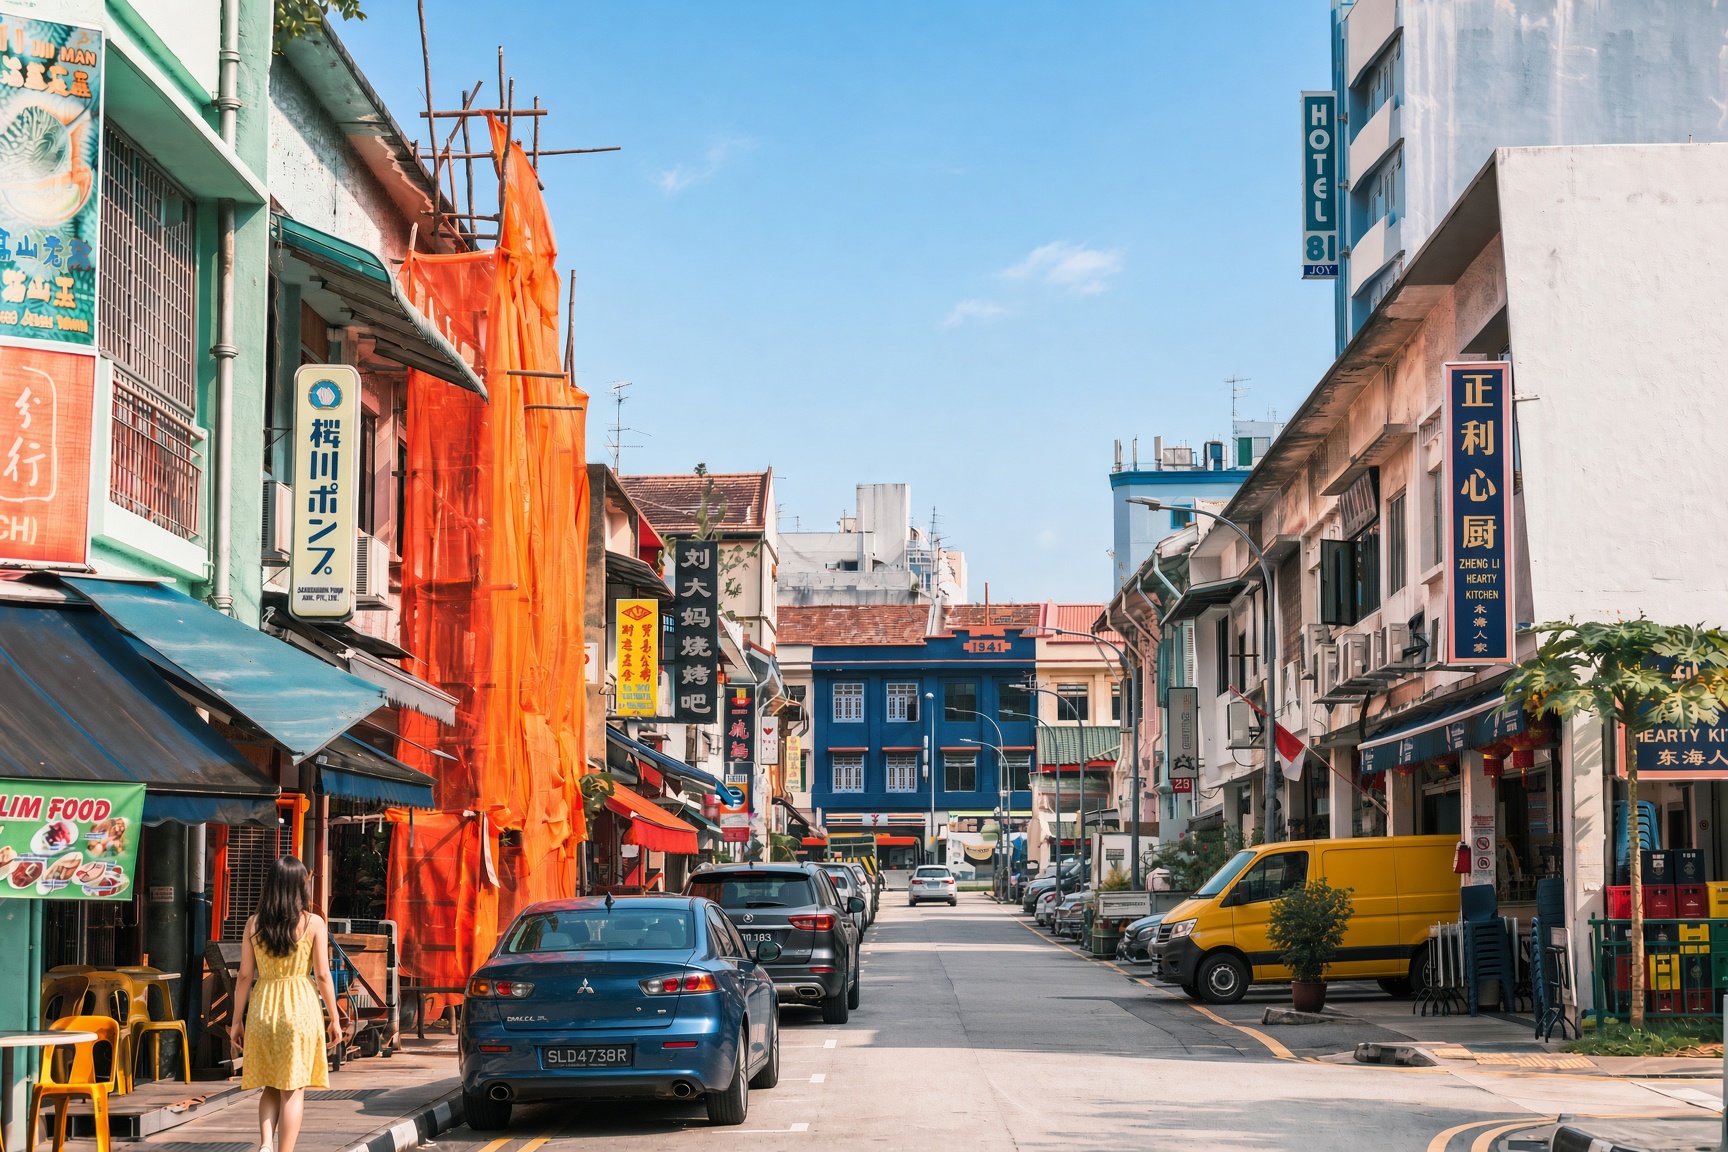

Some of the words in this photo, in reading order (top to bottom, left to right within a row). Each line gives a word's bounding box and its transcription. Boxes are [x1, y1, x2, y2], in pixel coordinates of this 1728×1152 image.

[60, 46, 96, 67] MAN
[1309, 104, 1330, 222] HOTEL
[1306, 235, 1336, 261] 81
[1310, 266, 1333, 275] JOY
[1461, 374, 1497, 549] 正利心厨
[307, 418, 341, 576] 桜川ポンプ
[1459, 559, 1488, 569] ZHENG
[1492, 558, 1500, 569] LI
[1466, 574, 1497, 584] HEARTY
[1466, 589, 1499, 600] KITCHEN
[680, 548, 712, 714] 刘大妈烧烤吧
[972, 643, 1002, 652] 1941
[1657, 748, 1728, 766] 东海人
[48, 798, 110, 821] FOOD
[548, 1049, 627, 1063] SLD4738R
